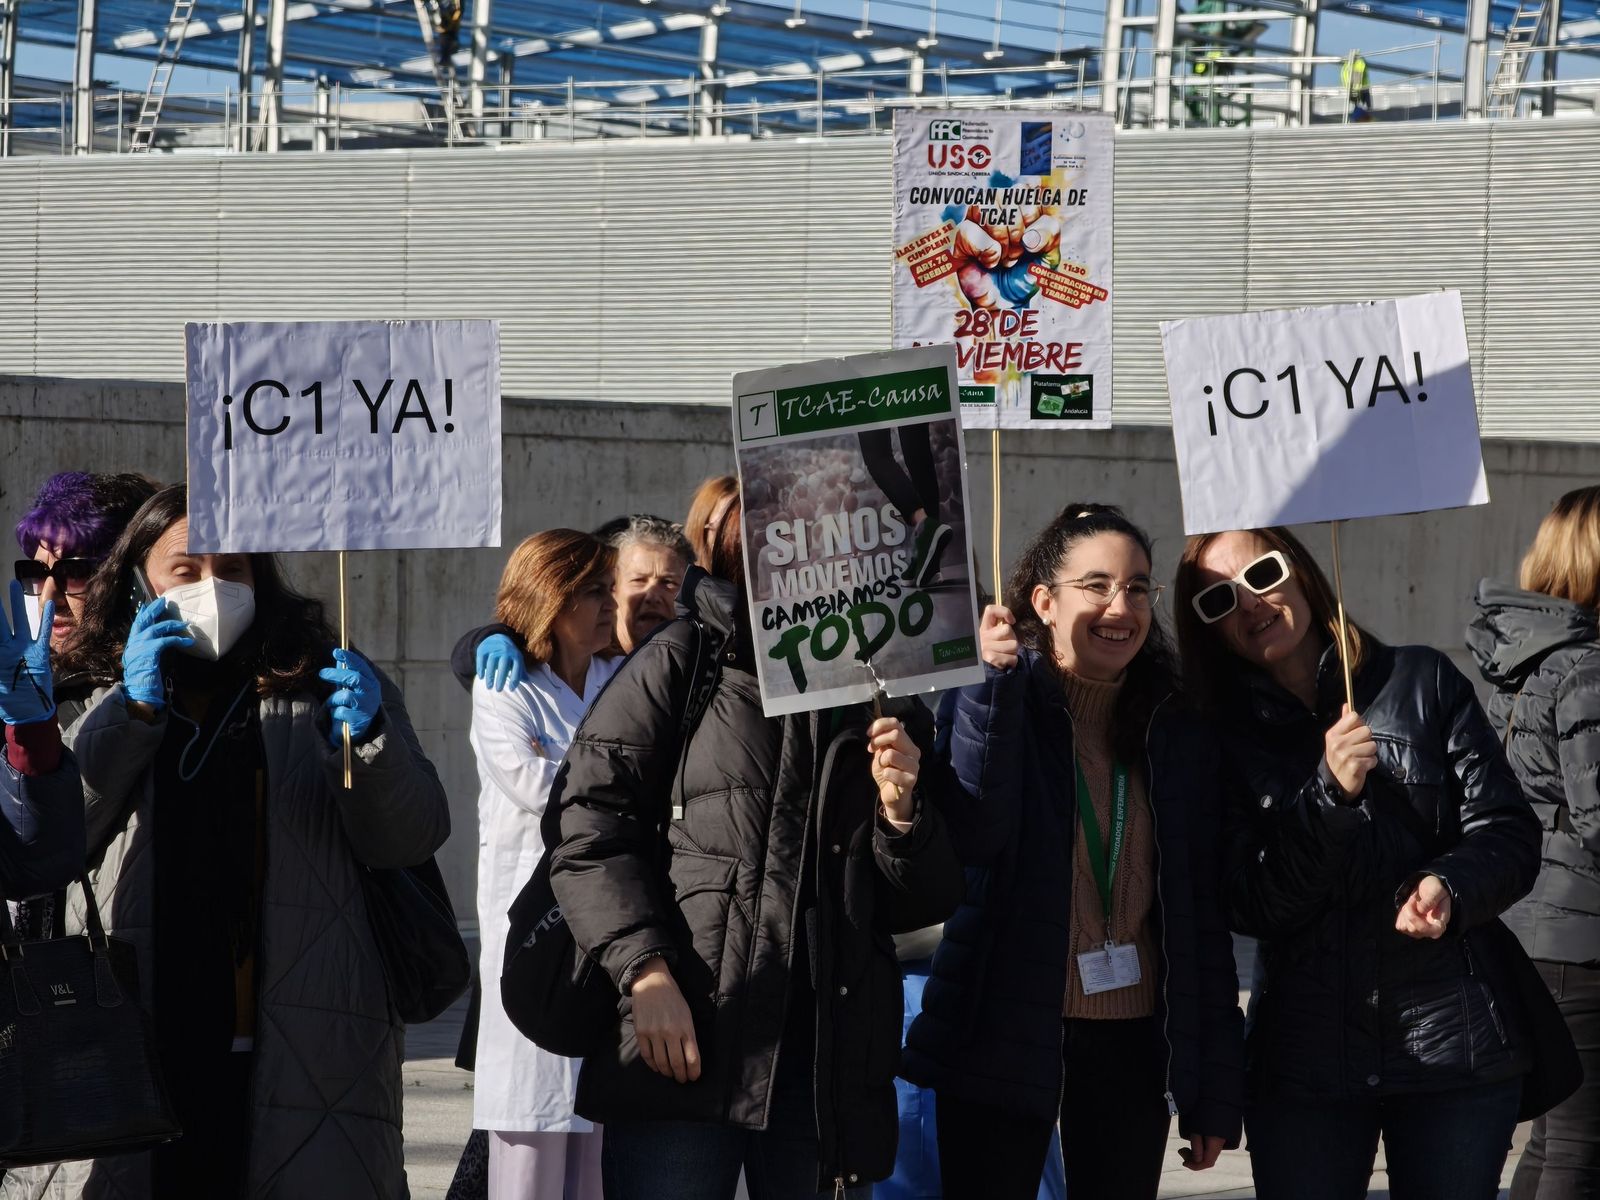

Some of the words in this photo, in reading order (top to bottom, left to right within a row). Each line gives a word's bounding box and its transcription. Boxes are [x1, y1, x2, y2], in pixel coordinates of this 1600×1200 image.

[928, 144, 991, 169] USO
[909, 187, 997, 206] CONVOCAN
[1002, 188, 1061, 206] HUELGA
[1067, 189, 1087, 206] DE
[980, 208, 1017, 226] TCAE
[915, 230, 941, 247] LEYES
[942, 223, 953, 233] SE
[918, 262, 953, 283] TREBEP
[1063, 263, 1086, 276] 11:30
[1039, 277, 1049, 286] EL
[1049, 281, 1079, 297] CENTRO
[1079, 292, 1091, 301] DE
[1045, 287, 1080, 306] TRABAJO
[1094, 289, 1105, 298] EN
[954, 310, 991, 337] 28
[999, 310, 1040, 338] DE
[912, 342, 1083, 374] VIEMBRE
[782, 382, 942, 421] TCAE-Causa
[1203, 365, 1302, 437] ¡C1
[1324, 351, 1428, 410] YA!
[222, 379, 323, 450] ¡C1
[352, 379, 455, 434] YA!
[750, 403, 768, 426] T
[766, 518, 809, 566] SI
[822, 503, 906, 558] NOS
[771, 549, 908, 600] MOVEMOS
[762, 576, 901, 631] CAMBIAMOS
[768, 591, 934, 694] TODO
[1112, 821, 1123, 860] CUIDADOS
[49, 983, 75, 996] V&L
